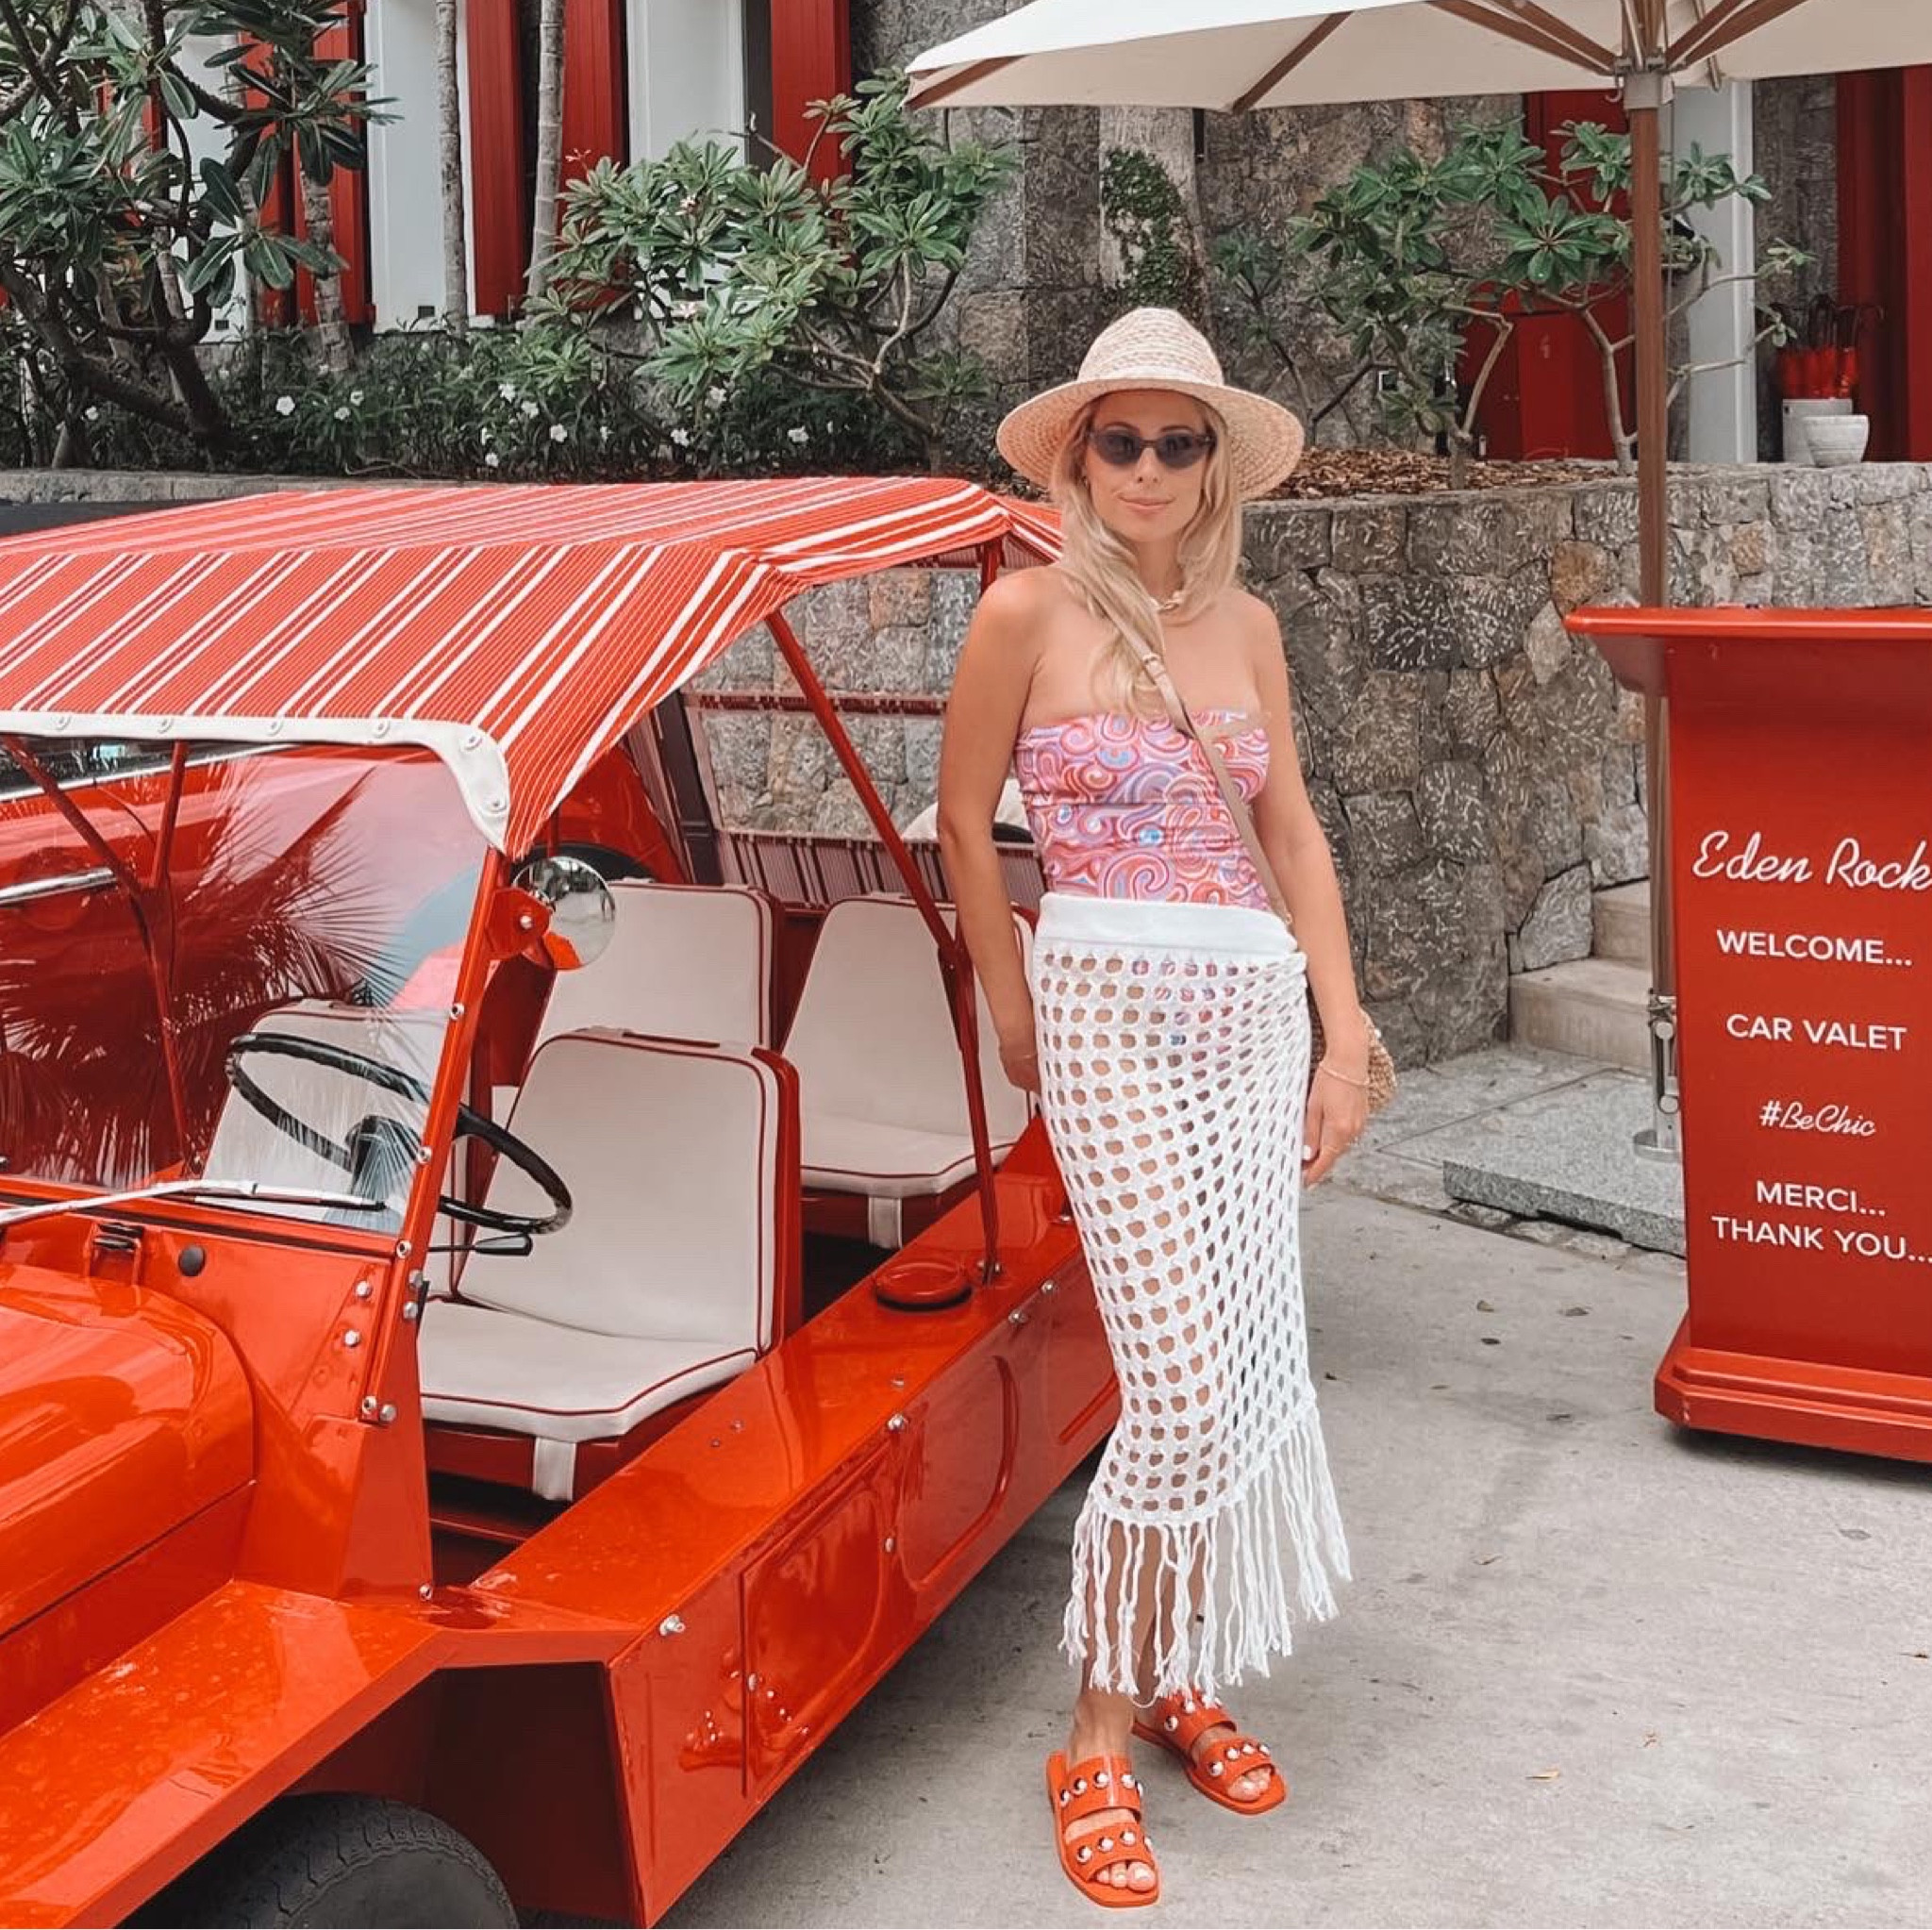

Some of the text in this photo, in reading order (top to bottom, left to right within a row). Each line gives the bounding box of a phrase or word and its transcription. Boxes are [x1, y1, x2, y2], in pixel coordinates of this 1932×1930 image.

[1691, 830, 1932, 890] Eden Rock
[1716, 929, 1912, 966] WELCOME...
[1726, 1013, 1907, 1051] CAR VALET
[1759, 1100, 1875, 1137] #BeChic
[1757, 1180, 1886, 1217] MERCI...
[1711, 1215, 1932, 1264] THANK YOU...
